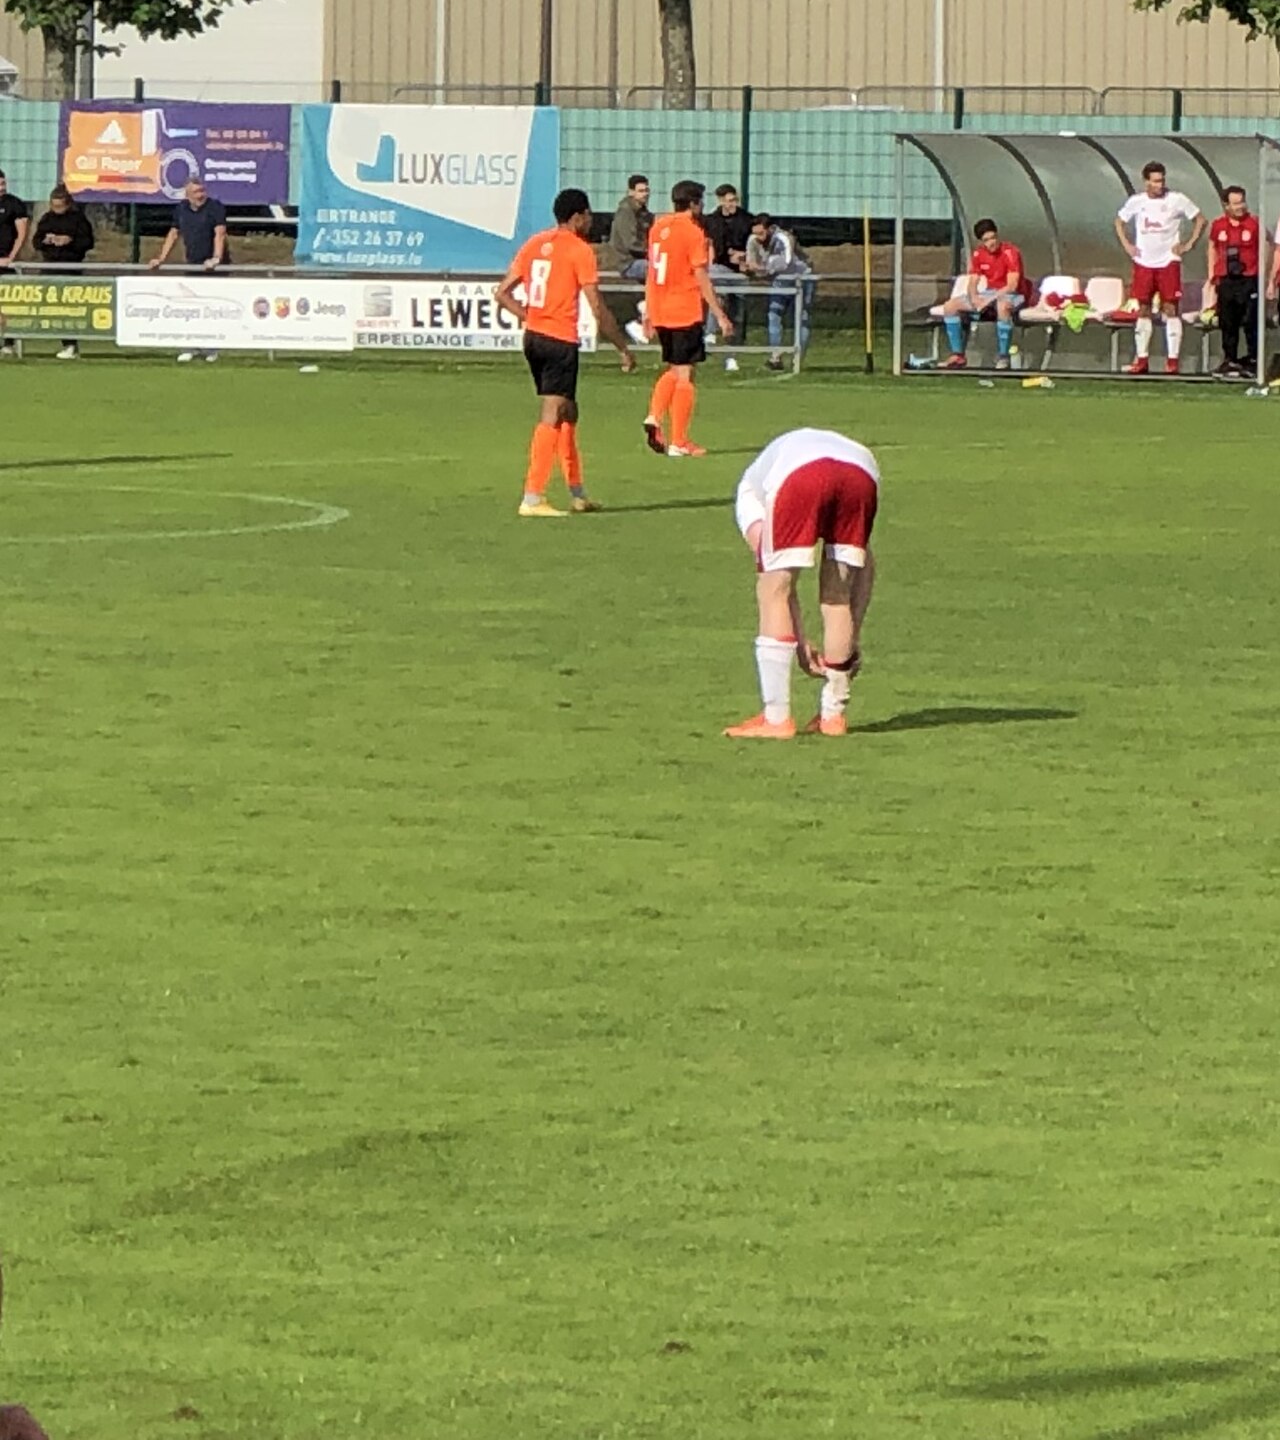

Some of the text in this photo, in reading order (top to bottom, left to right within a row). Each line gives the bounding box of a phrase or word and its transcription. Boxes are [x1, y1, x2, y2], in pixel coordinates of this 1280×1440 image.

[398, 153, 518, 186] LUXGLASS
[652, 243, 667, 285] 4
[529, 259, 552, 308] 8
[313, 301, 346, 317] Jeep
[411, 298, 522, 329] LEWEC
[356, 333, 472, 347] ERPELDANGE
